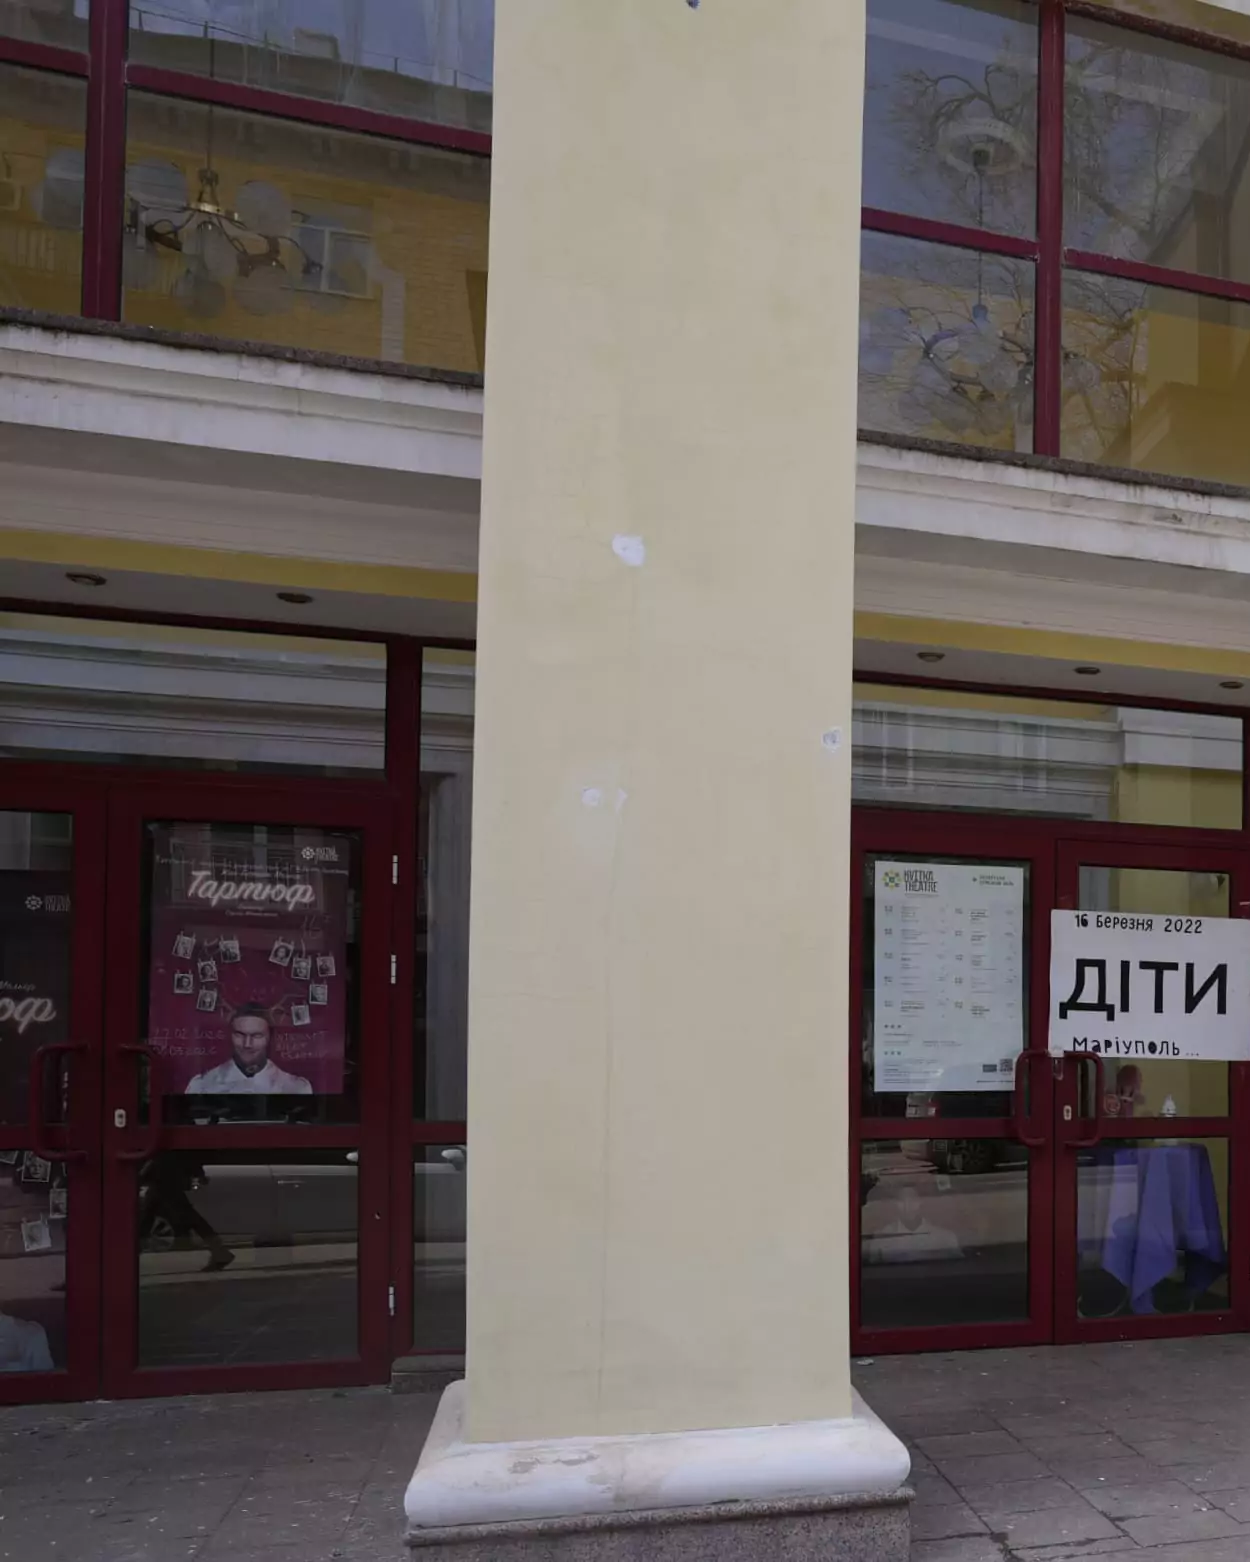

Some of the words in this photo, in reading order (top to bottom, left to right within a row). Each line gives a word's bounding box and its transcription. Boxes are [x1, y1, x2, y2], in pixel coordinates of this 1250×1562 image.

[187, 870, 316, 911] Тартюф
[904, 881, 938, 893] THEATRE
[1075, 914, 1089, 928] 16
[1096, 915, 1154, 932] Березня
[1164, 919, 1203, 934] 2022
[1059, 958, 1228, 1022] ДІТИ
